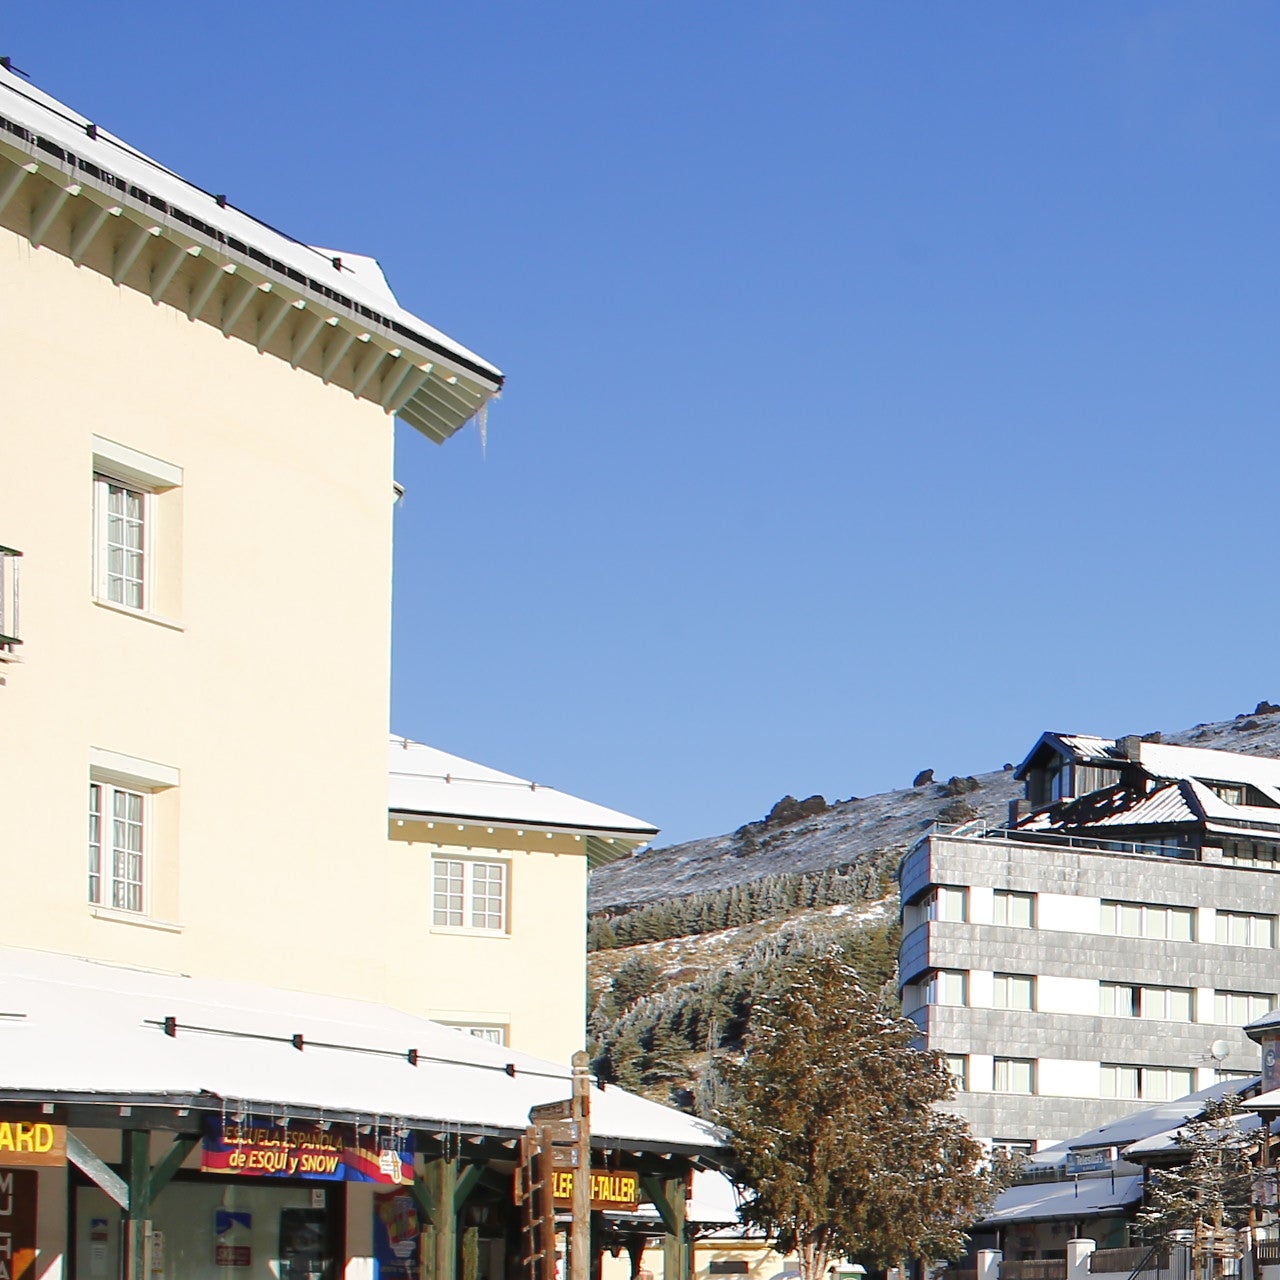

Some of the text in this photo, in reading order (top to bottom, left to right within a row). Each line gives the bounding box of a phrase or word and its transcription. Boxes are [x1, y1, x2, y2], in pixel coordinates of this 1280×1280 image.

[223, 1126, 345, 1150] ESCUELA ESPAÑOLA
[229, 1148, 339, 1174] de ESQUÍ y SNOW
